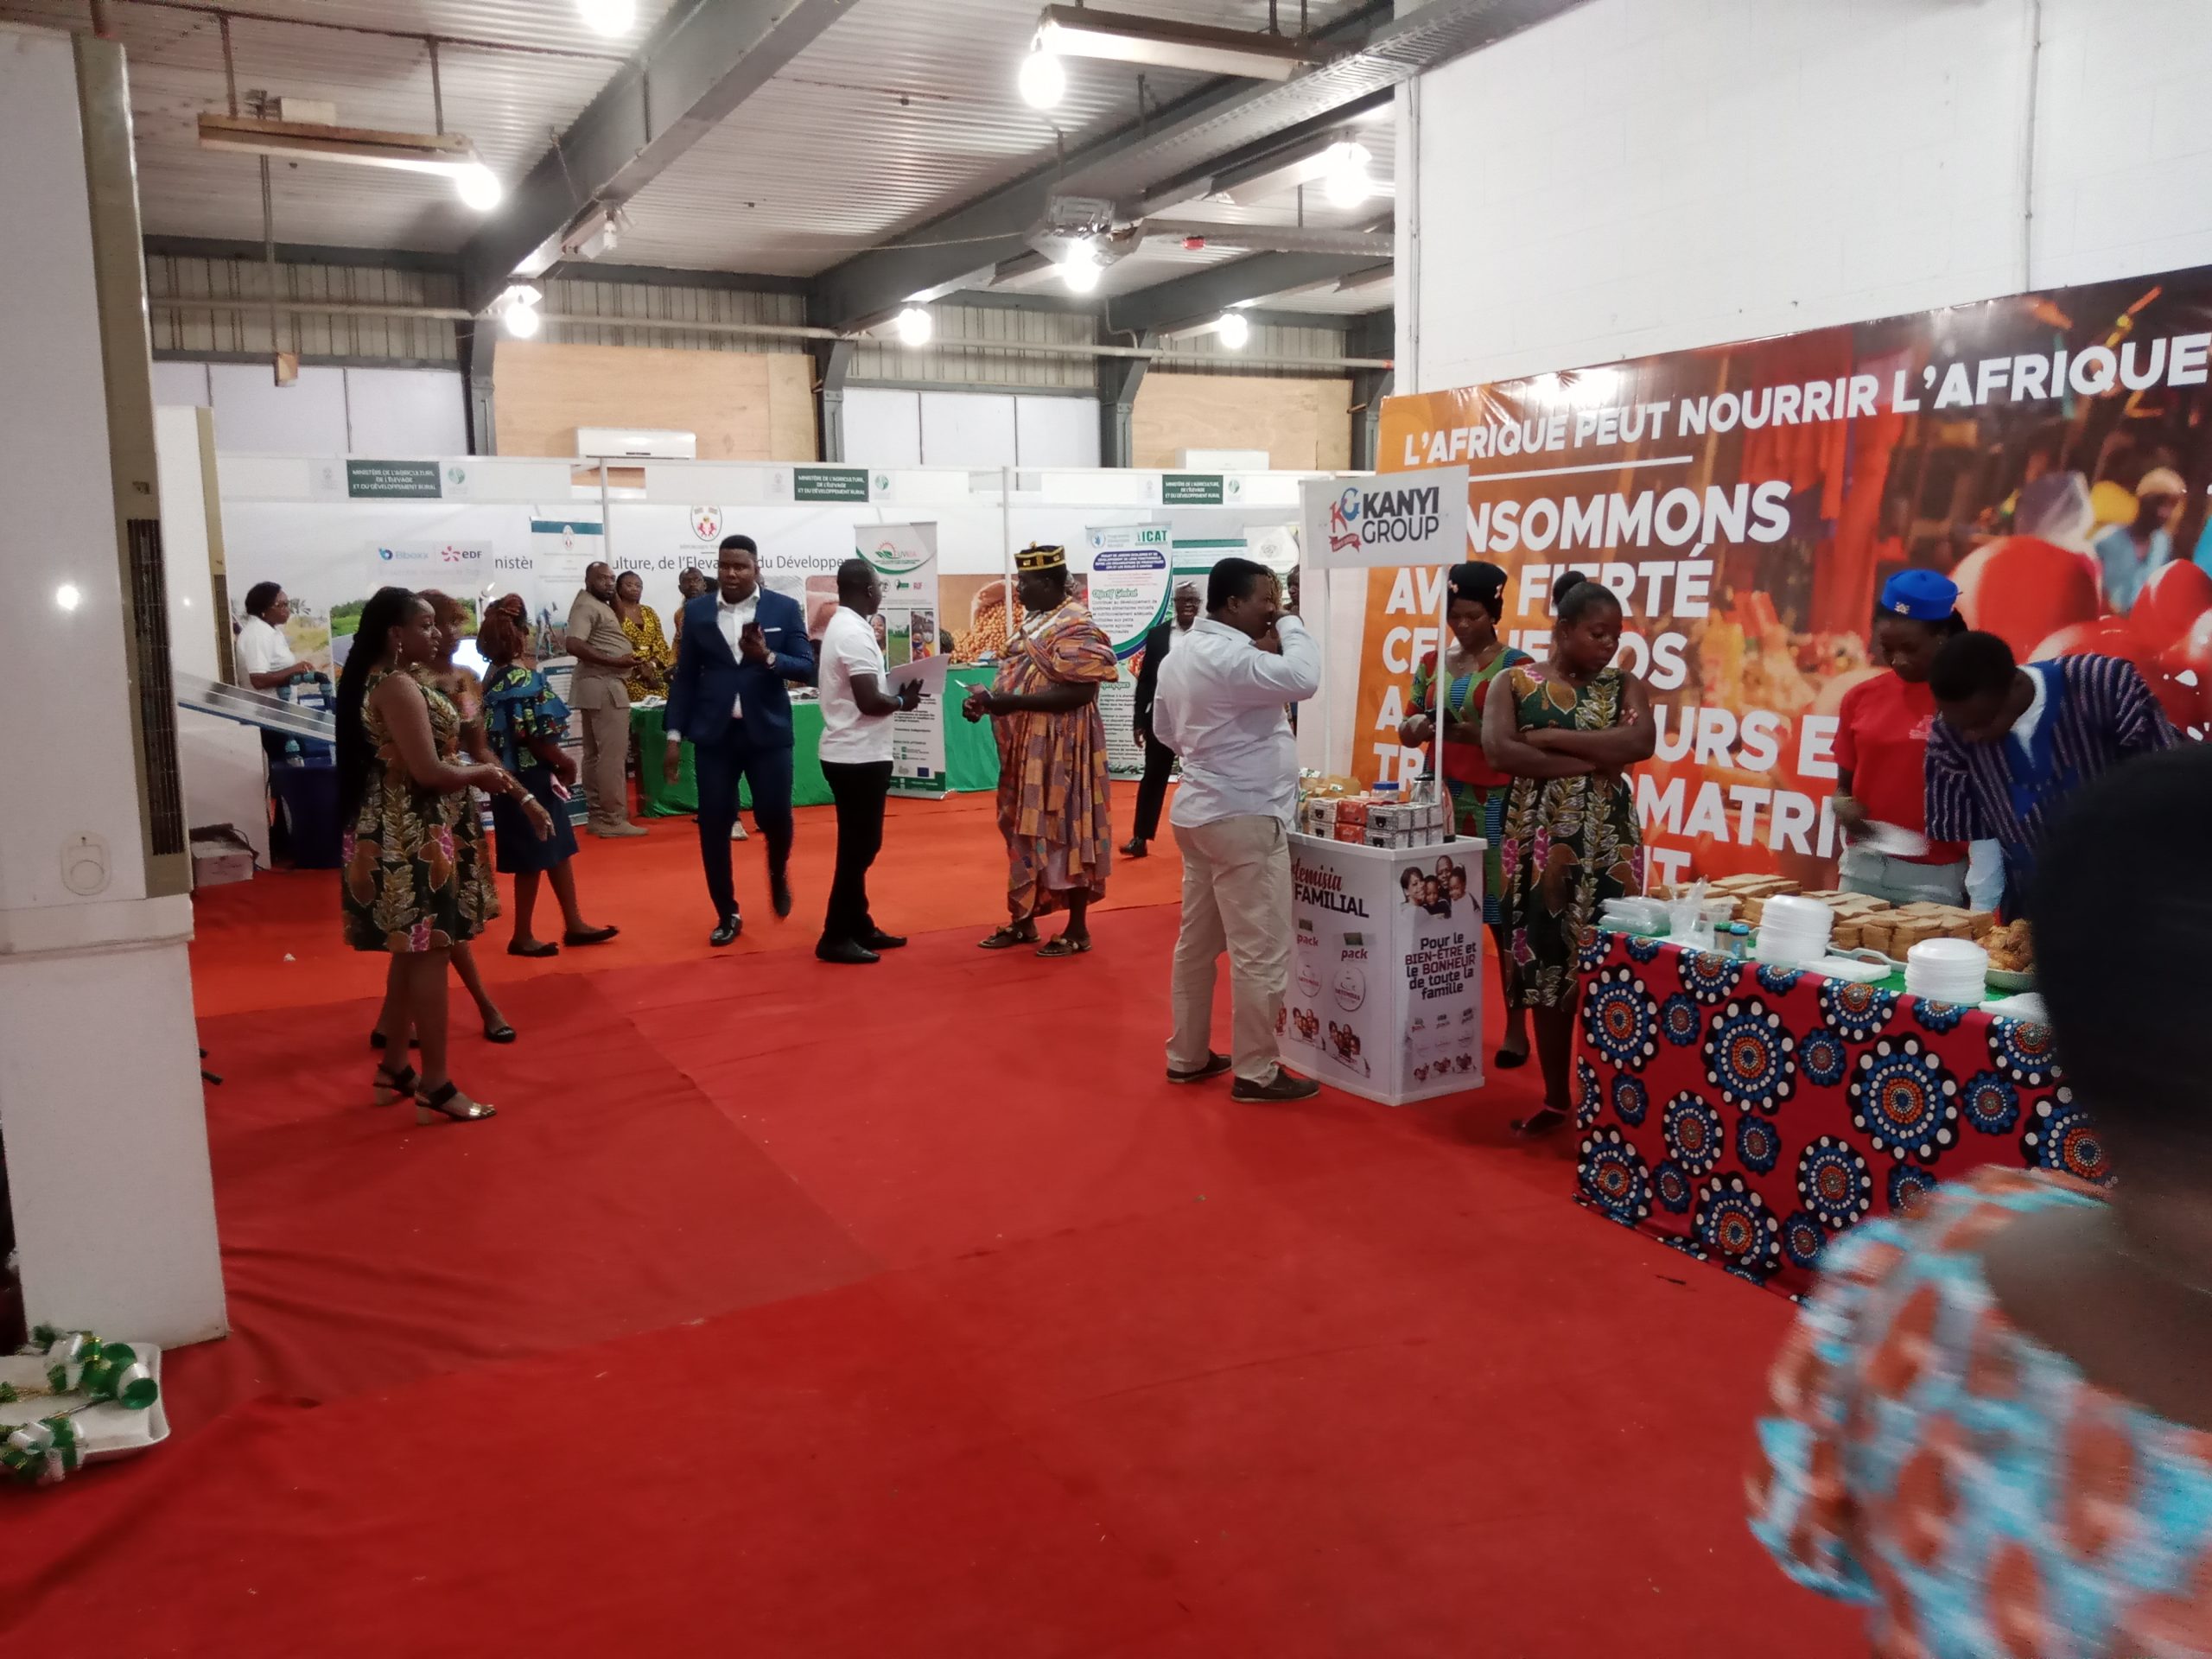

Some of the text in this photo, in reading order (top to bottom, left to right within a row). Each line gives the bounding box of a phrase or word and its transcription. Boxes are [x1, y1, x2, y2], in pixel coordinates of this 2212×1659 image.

[1403, 333, 2212, 467] L'AFRIQUE PEUT NOURRIR L'AFRIQUE
[1363, 486, 1440, 518] KANYI
[1468, 480, 1791, 553] NSOMMONS
[1362, 516, 1439, 544] GROUP
[658, 556, 676, 569] de
[679, 556, 719, 569] l'Eleva
[777, 556, 850, 572] Développe
[1291, 857, 1342, 892] temisia
[1294, 882, 1370, 918] FAMILIAL
[1297, 933, 1319, 947] pack
[1421, 931, 1464, 950] Pour le
[1465, 942, 1477, 954] et
[1340, 948, 1368, 962] pack
[1406, 954, 1476, 978] le BONHEUR
[1409, 966, 1474, 990] de toute la
[1421, 982, 1464, 1001] famille
